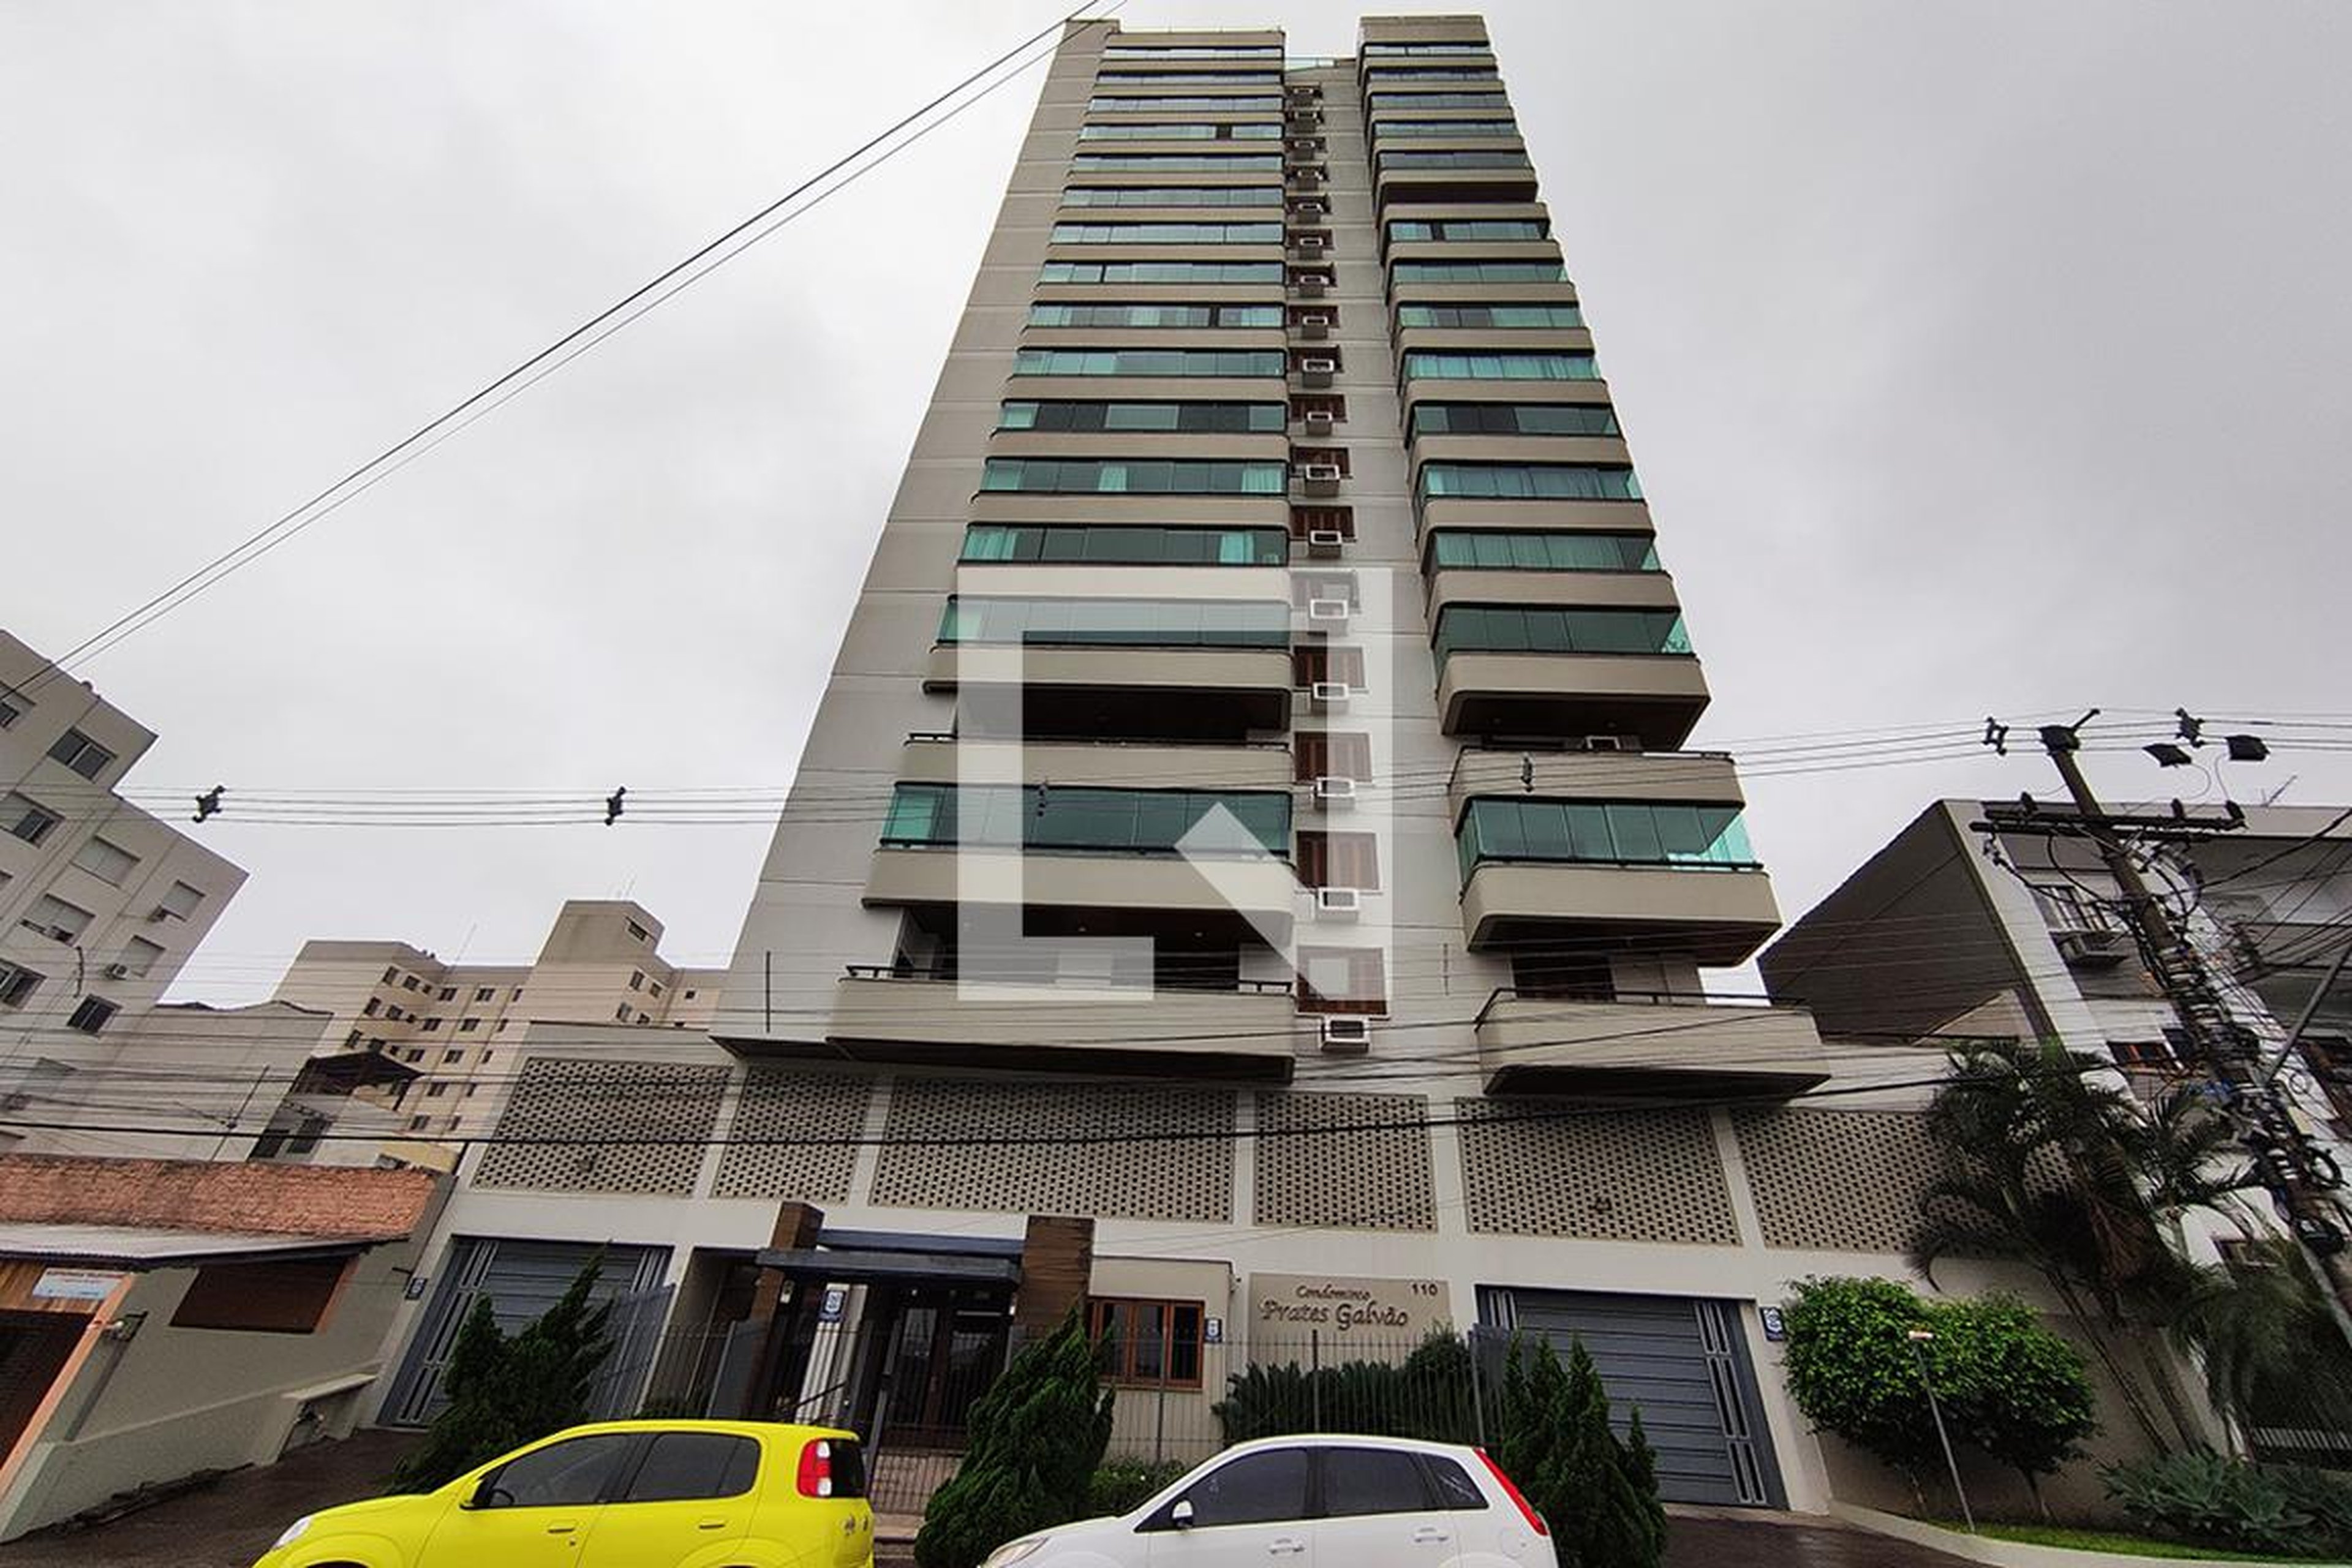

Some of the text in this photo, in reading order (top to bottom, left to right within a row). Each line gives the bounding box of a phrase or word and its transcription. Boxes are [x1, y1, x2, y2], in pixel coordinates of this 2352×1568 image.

[1411, 1283, 1438, 1297] 110
[1261, 1299, 1408, 1331] Prates Galvão
